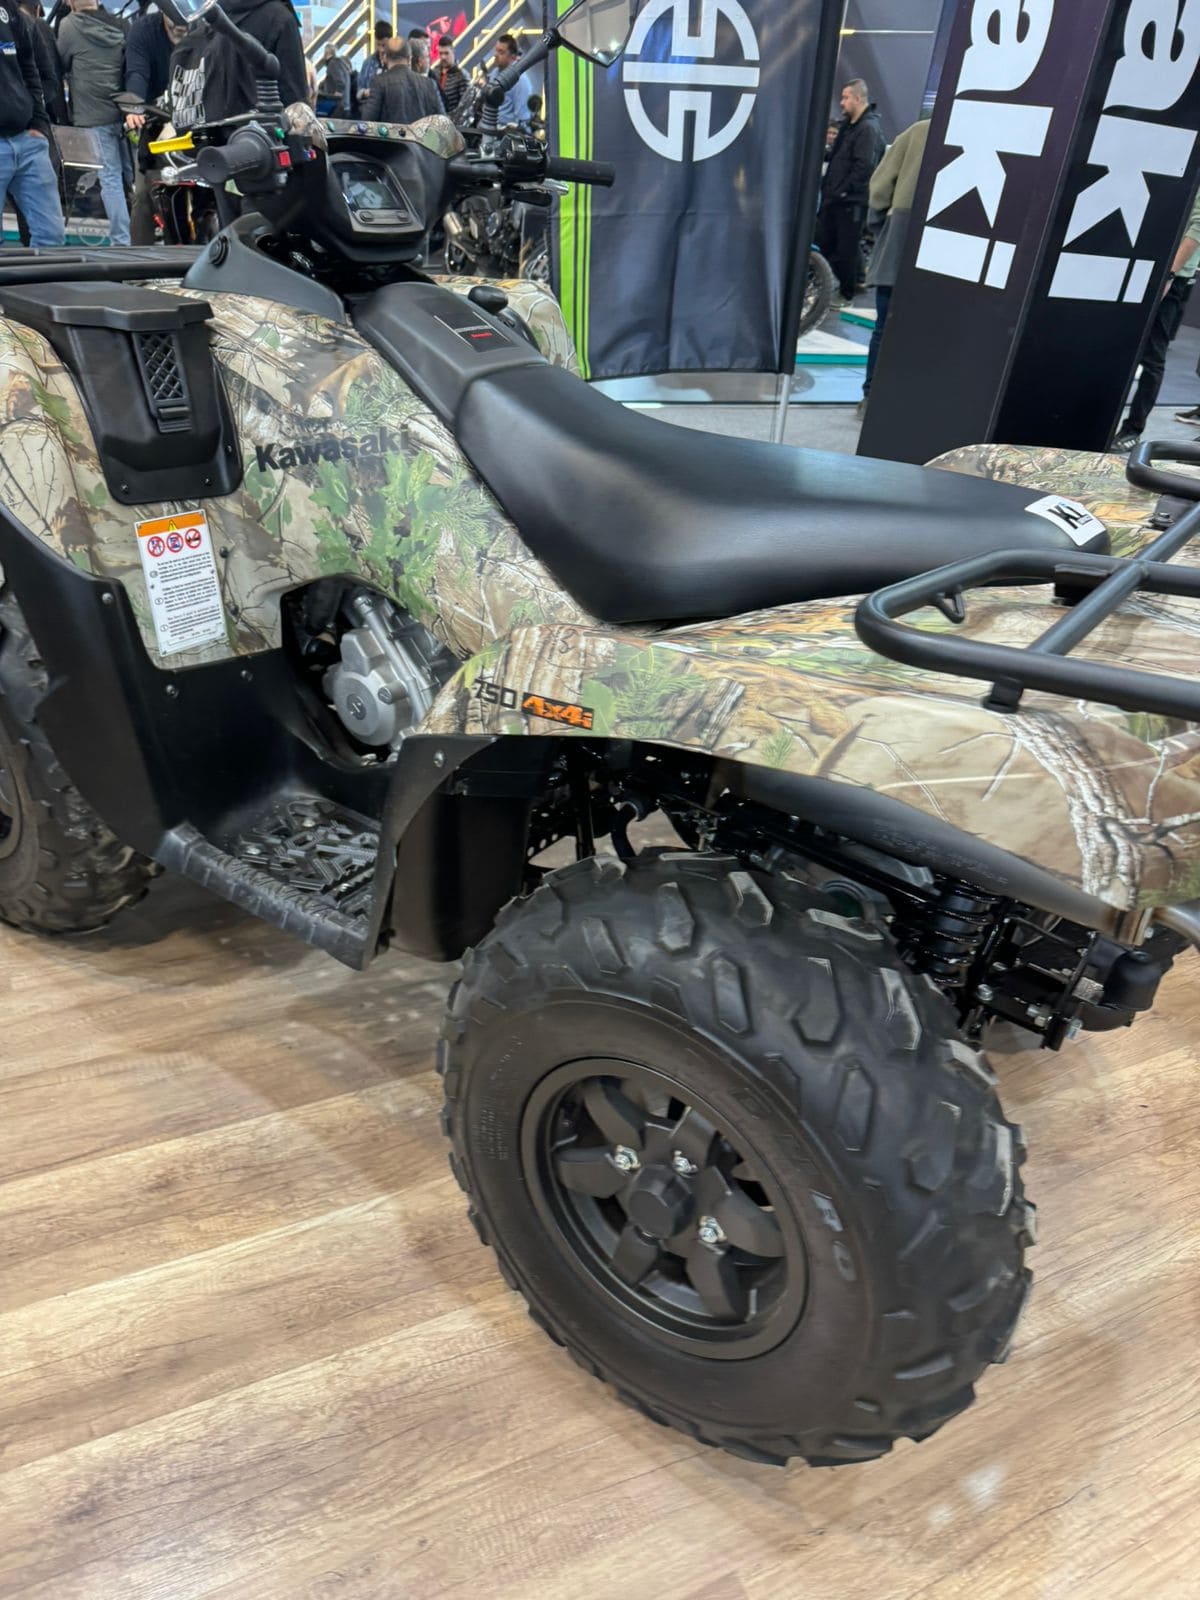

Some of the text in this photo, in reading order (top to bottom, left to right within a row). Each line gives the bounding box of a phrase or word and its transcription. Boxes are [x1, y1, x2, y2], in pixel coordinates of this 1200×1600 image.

[915, 0, 1054, 289] aki
[255, 424, 410, 472] Kawasaki
[474, 679, 517, 709] 750
